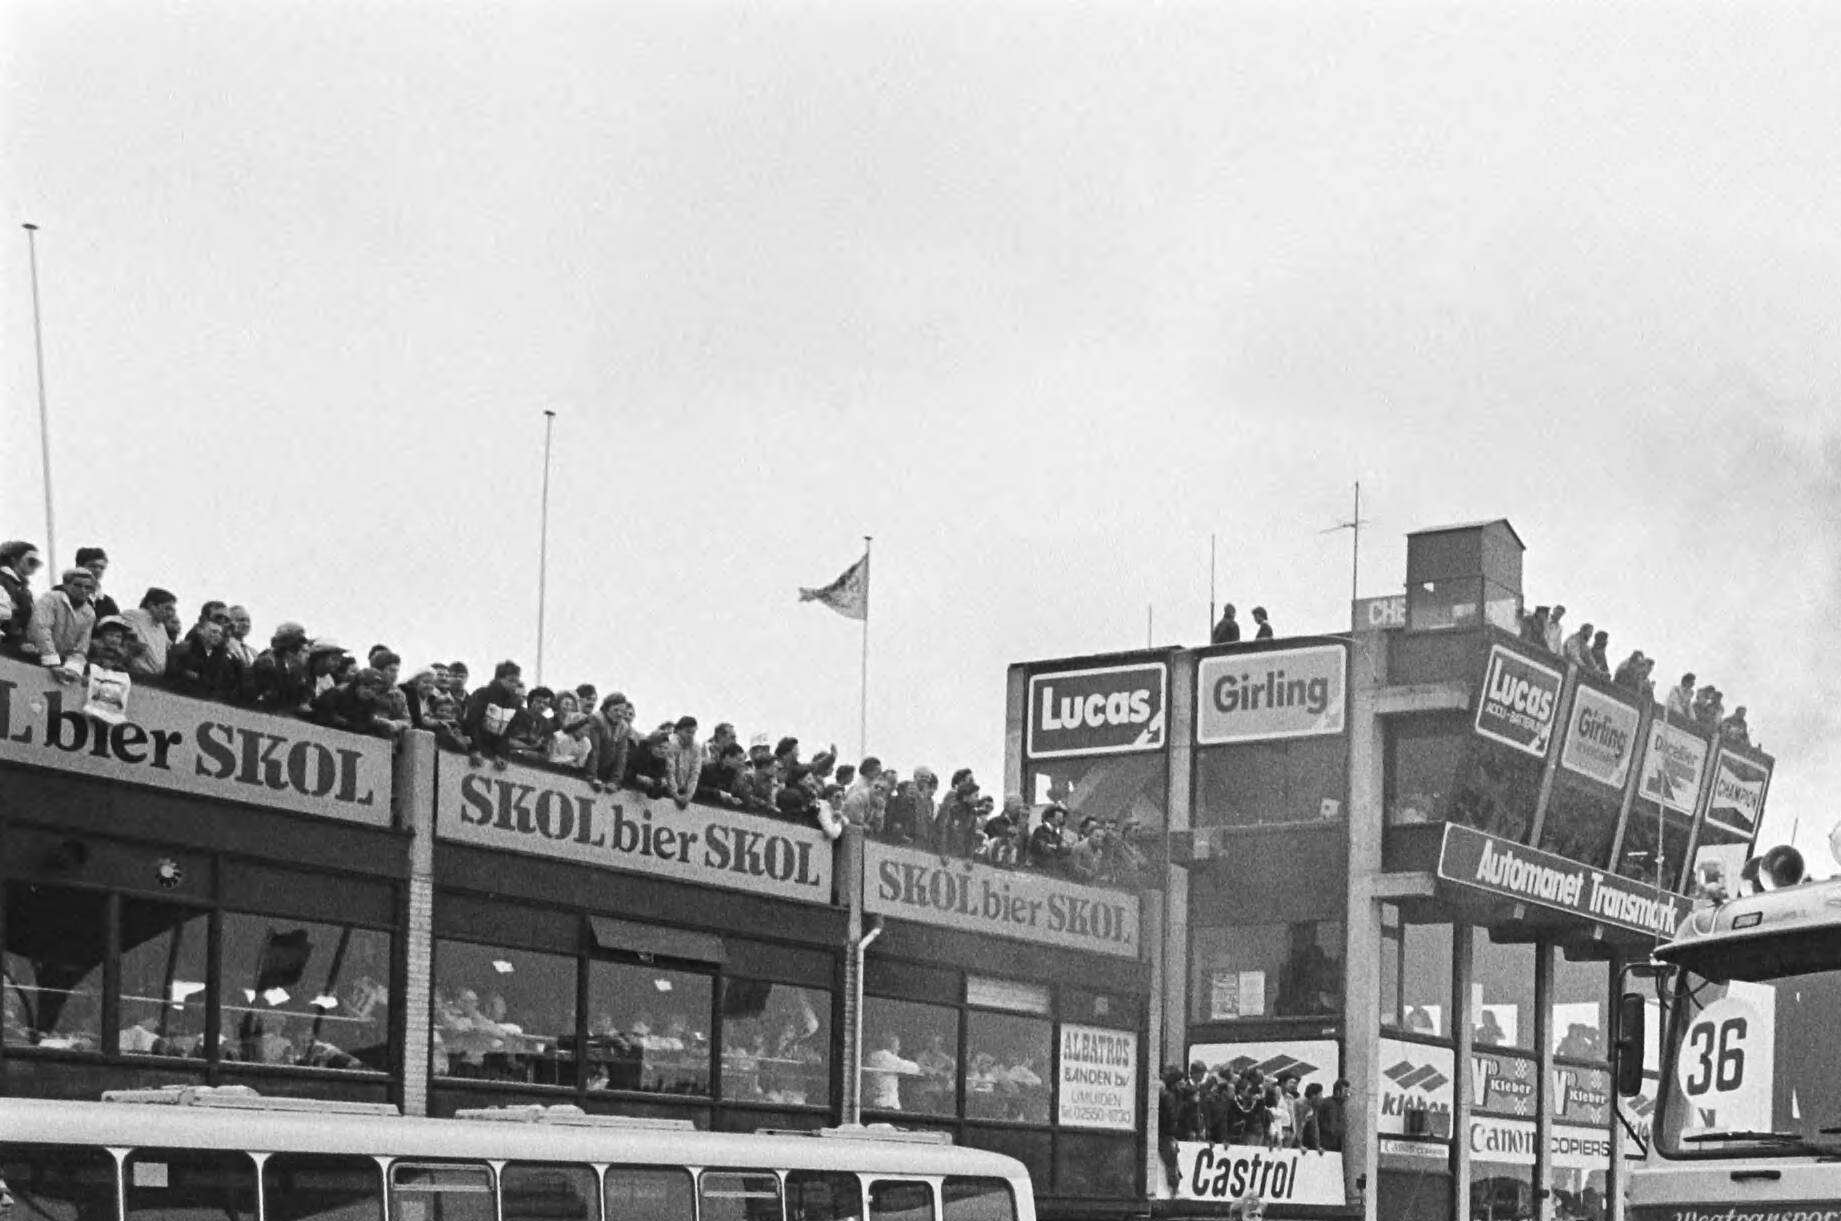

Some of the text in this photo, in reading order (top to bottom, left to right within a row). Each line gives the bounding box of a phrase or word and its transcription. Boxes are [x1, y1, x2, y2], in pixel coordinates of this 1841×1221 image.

[1042, 686, 1151, 731] Lucas
[1213, 669, 1329, 715] Girling
[1488, 657, 1553, 720] Lucas
[43, 691, 182, 770] bier
[195, 721, 375, 808] SKOL
[1578, 706, 1628, 759] Girling
[1717, 779, 1759, 812] CHAMPION
[461, 773, 820, 887] SKOL bier SKOL
[878, 858, 1132, 946] SKOL bier SKOL
[1063, 1031, 1130, 1067] ALBATROS
[1687, 1018, 1747, 1096] 36
[1064, 1067, 1111, 1086] BANDEN
[1491, 1078, 1532, 1095] Kleber
[1569, 1089, 1607, 1105] Kleber
[1551, 1137, 1610, 1157] COPIERS
[1192, 1147, 1298, 1200] Castrol
